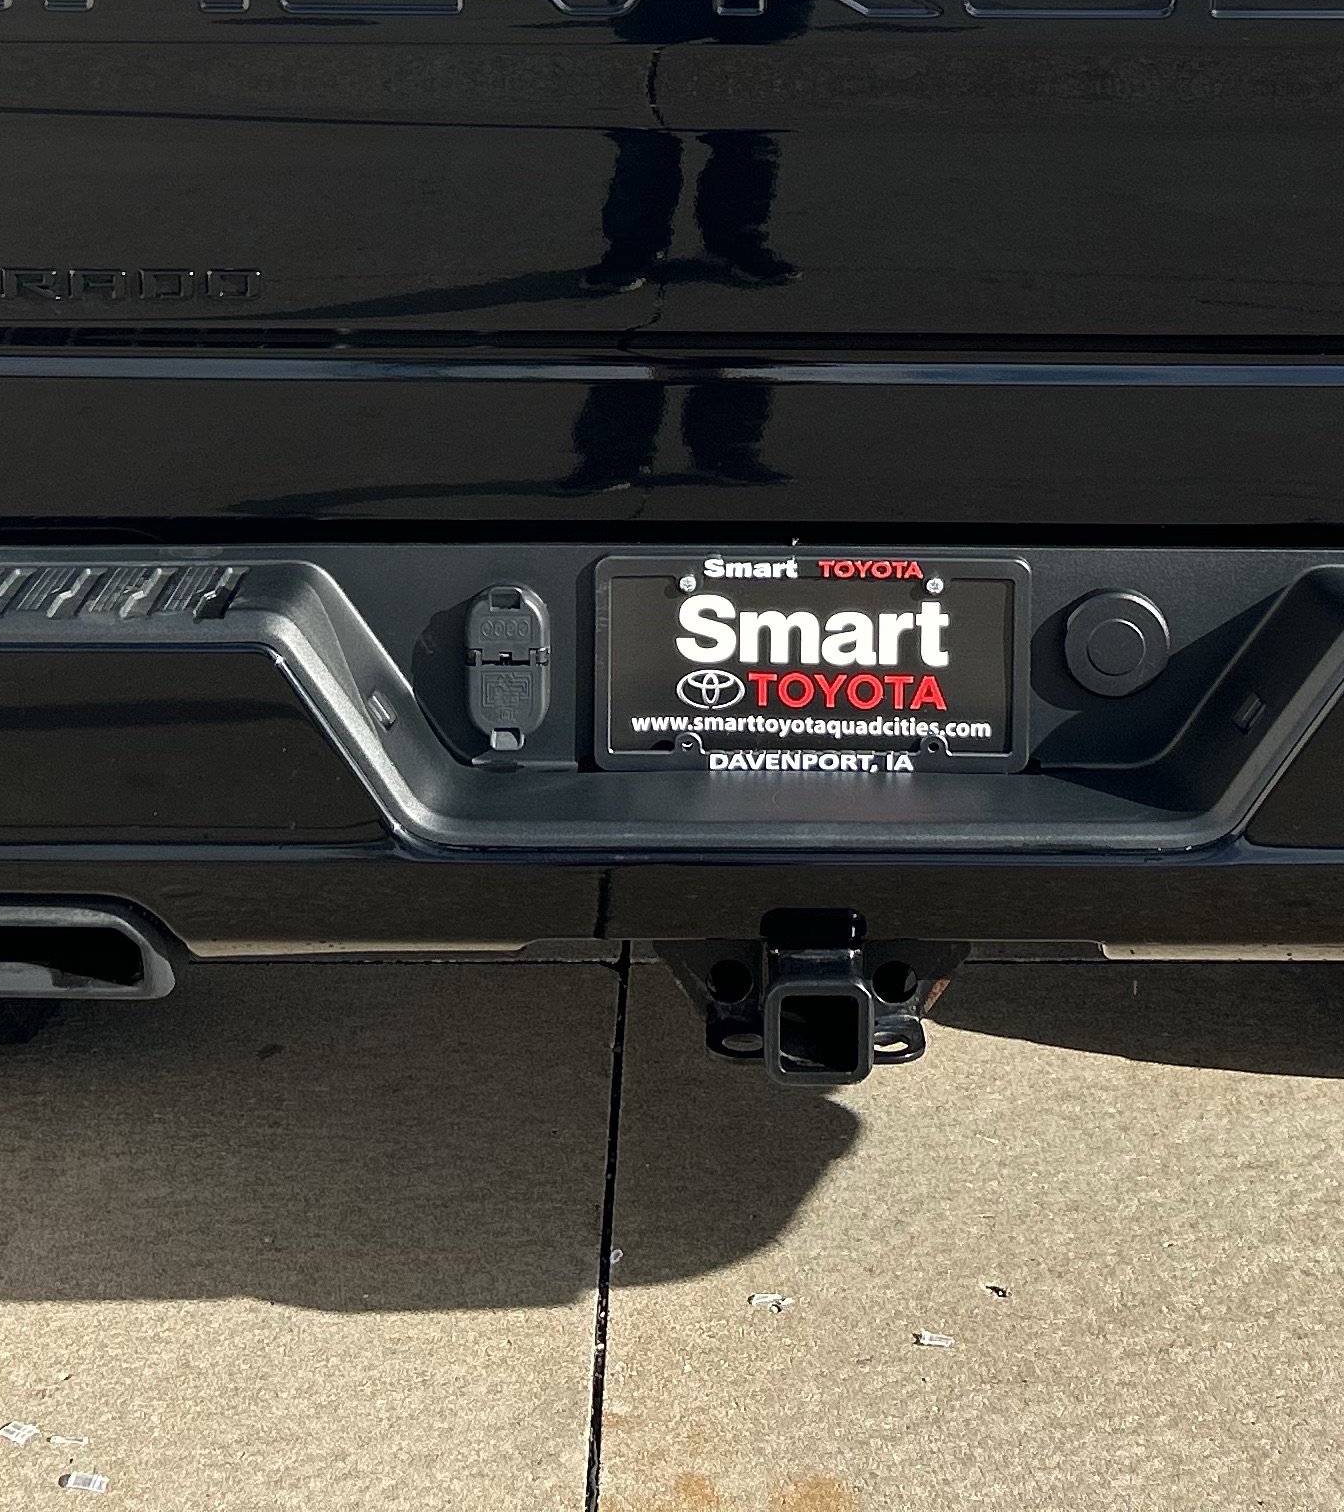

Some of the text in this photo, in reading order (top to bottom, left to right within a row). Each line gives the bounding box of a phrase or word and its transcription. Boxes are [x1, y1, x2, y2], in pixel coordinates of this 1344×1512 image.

[703, 557, 924, 580] Smart TOYOTA
[675, 593, 950, 667] Smart
[748, 672, 948, 711] TOYOTA
[631, 714, 992, 739] www.smarttoyotaquadcities.com
[708, 753, 914, 773] DAVENPORT, IA
